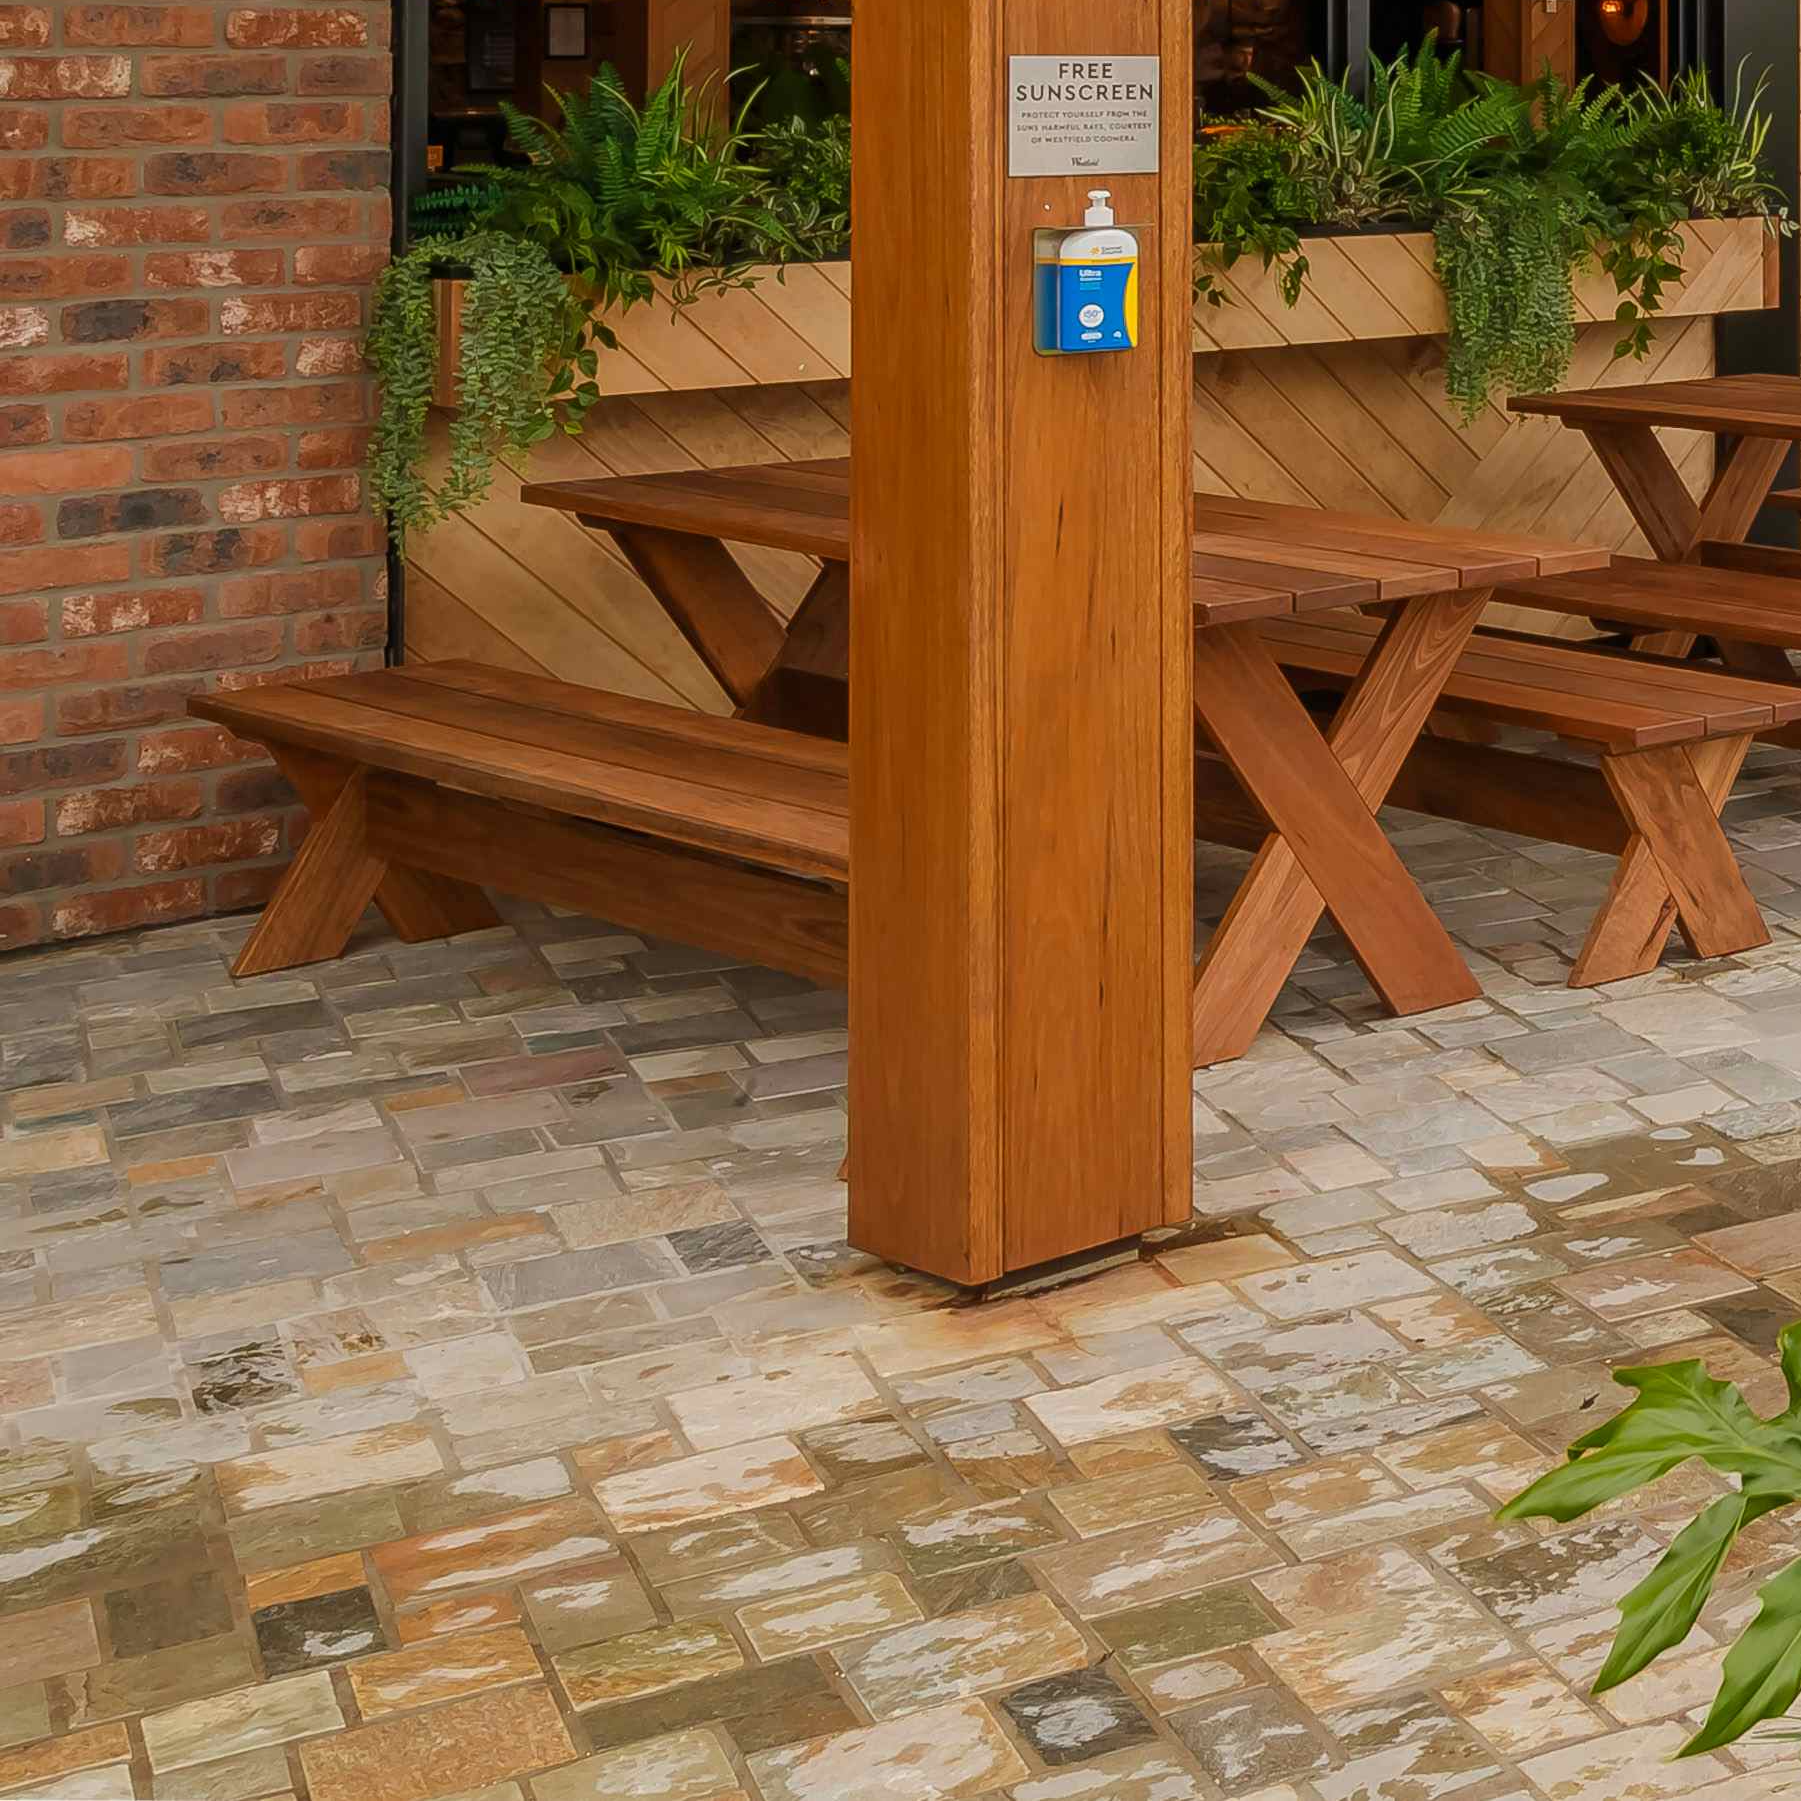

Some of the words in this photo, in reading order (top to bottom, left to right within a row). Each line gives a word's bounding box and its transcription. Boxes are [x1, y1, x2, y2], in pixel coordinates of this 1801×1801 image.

[1059, 63, 1113, 79] FREE
[1016, 84, 1153, 101] SUNSCREEN
[1021, 111, 1059, 119] PROTECT
[1062, 110, 1104, 119] YOURSELF
[1106, 110, 1130, 118] FROM
[1132, 109, 1148, 118] THE
[1041, 123, 1081, 131] HARMFUL
[1109, 122, 1153, 130] COURTESY
[1031, 136, 1042, 144] OF
[1045, 135, 1092, 144] WESTFIELD
